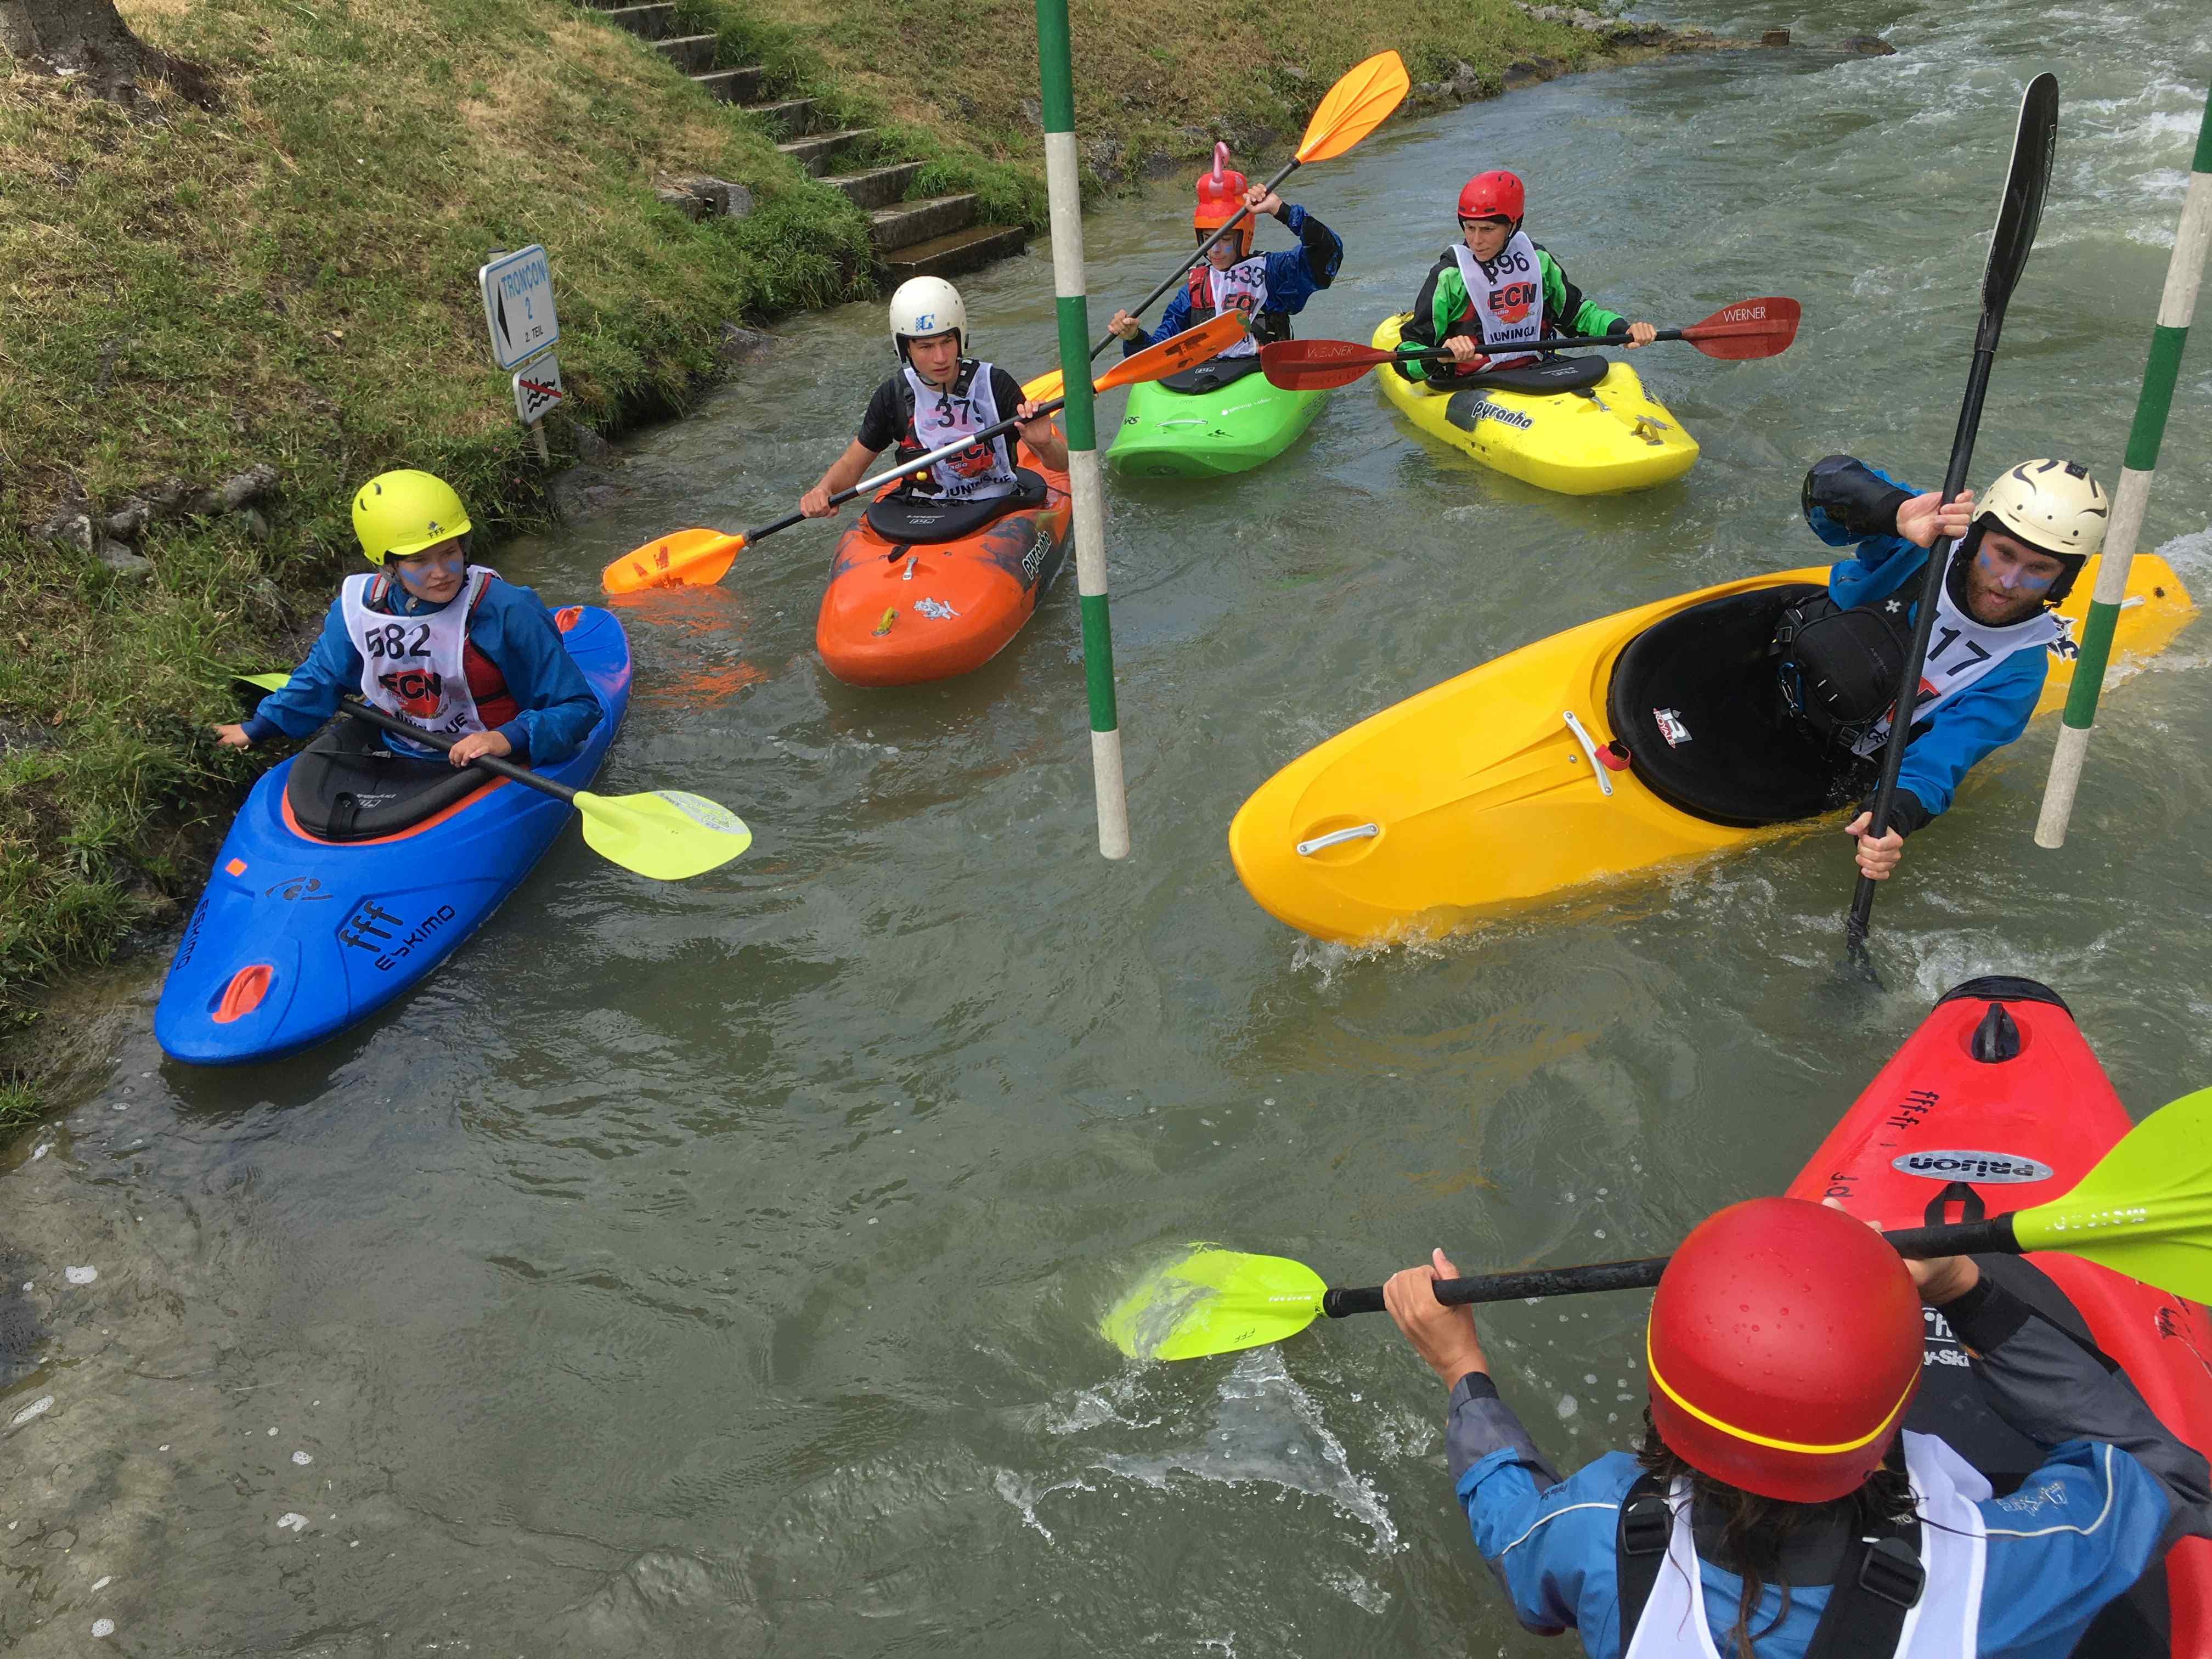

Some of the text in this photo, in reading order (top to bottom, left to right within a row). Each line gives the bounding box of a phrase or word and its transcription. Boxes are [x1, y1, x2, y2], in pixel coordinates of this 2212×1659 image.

[1224, 265, 1265, 288] 433
[525, 297, 533, 320] 2
[1489, 283, 1537, 311] ECN
[1723, 306, 1766, 322] WERNER
[532, 325, 544, 340] TEIL
[365, 623, 431, 659] 582
[1927, 610, 1992, 676] 17
[378, 672, 442, 702] ECN
[1653, 710, 1677, 749] ROYALE
[374, 904, 456, 971] ESKIMO
